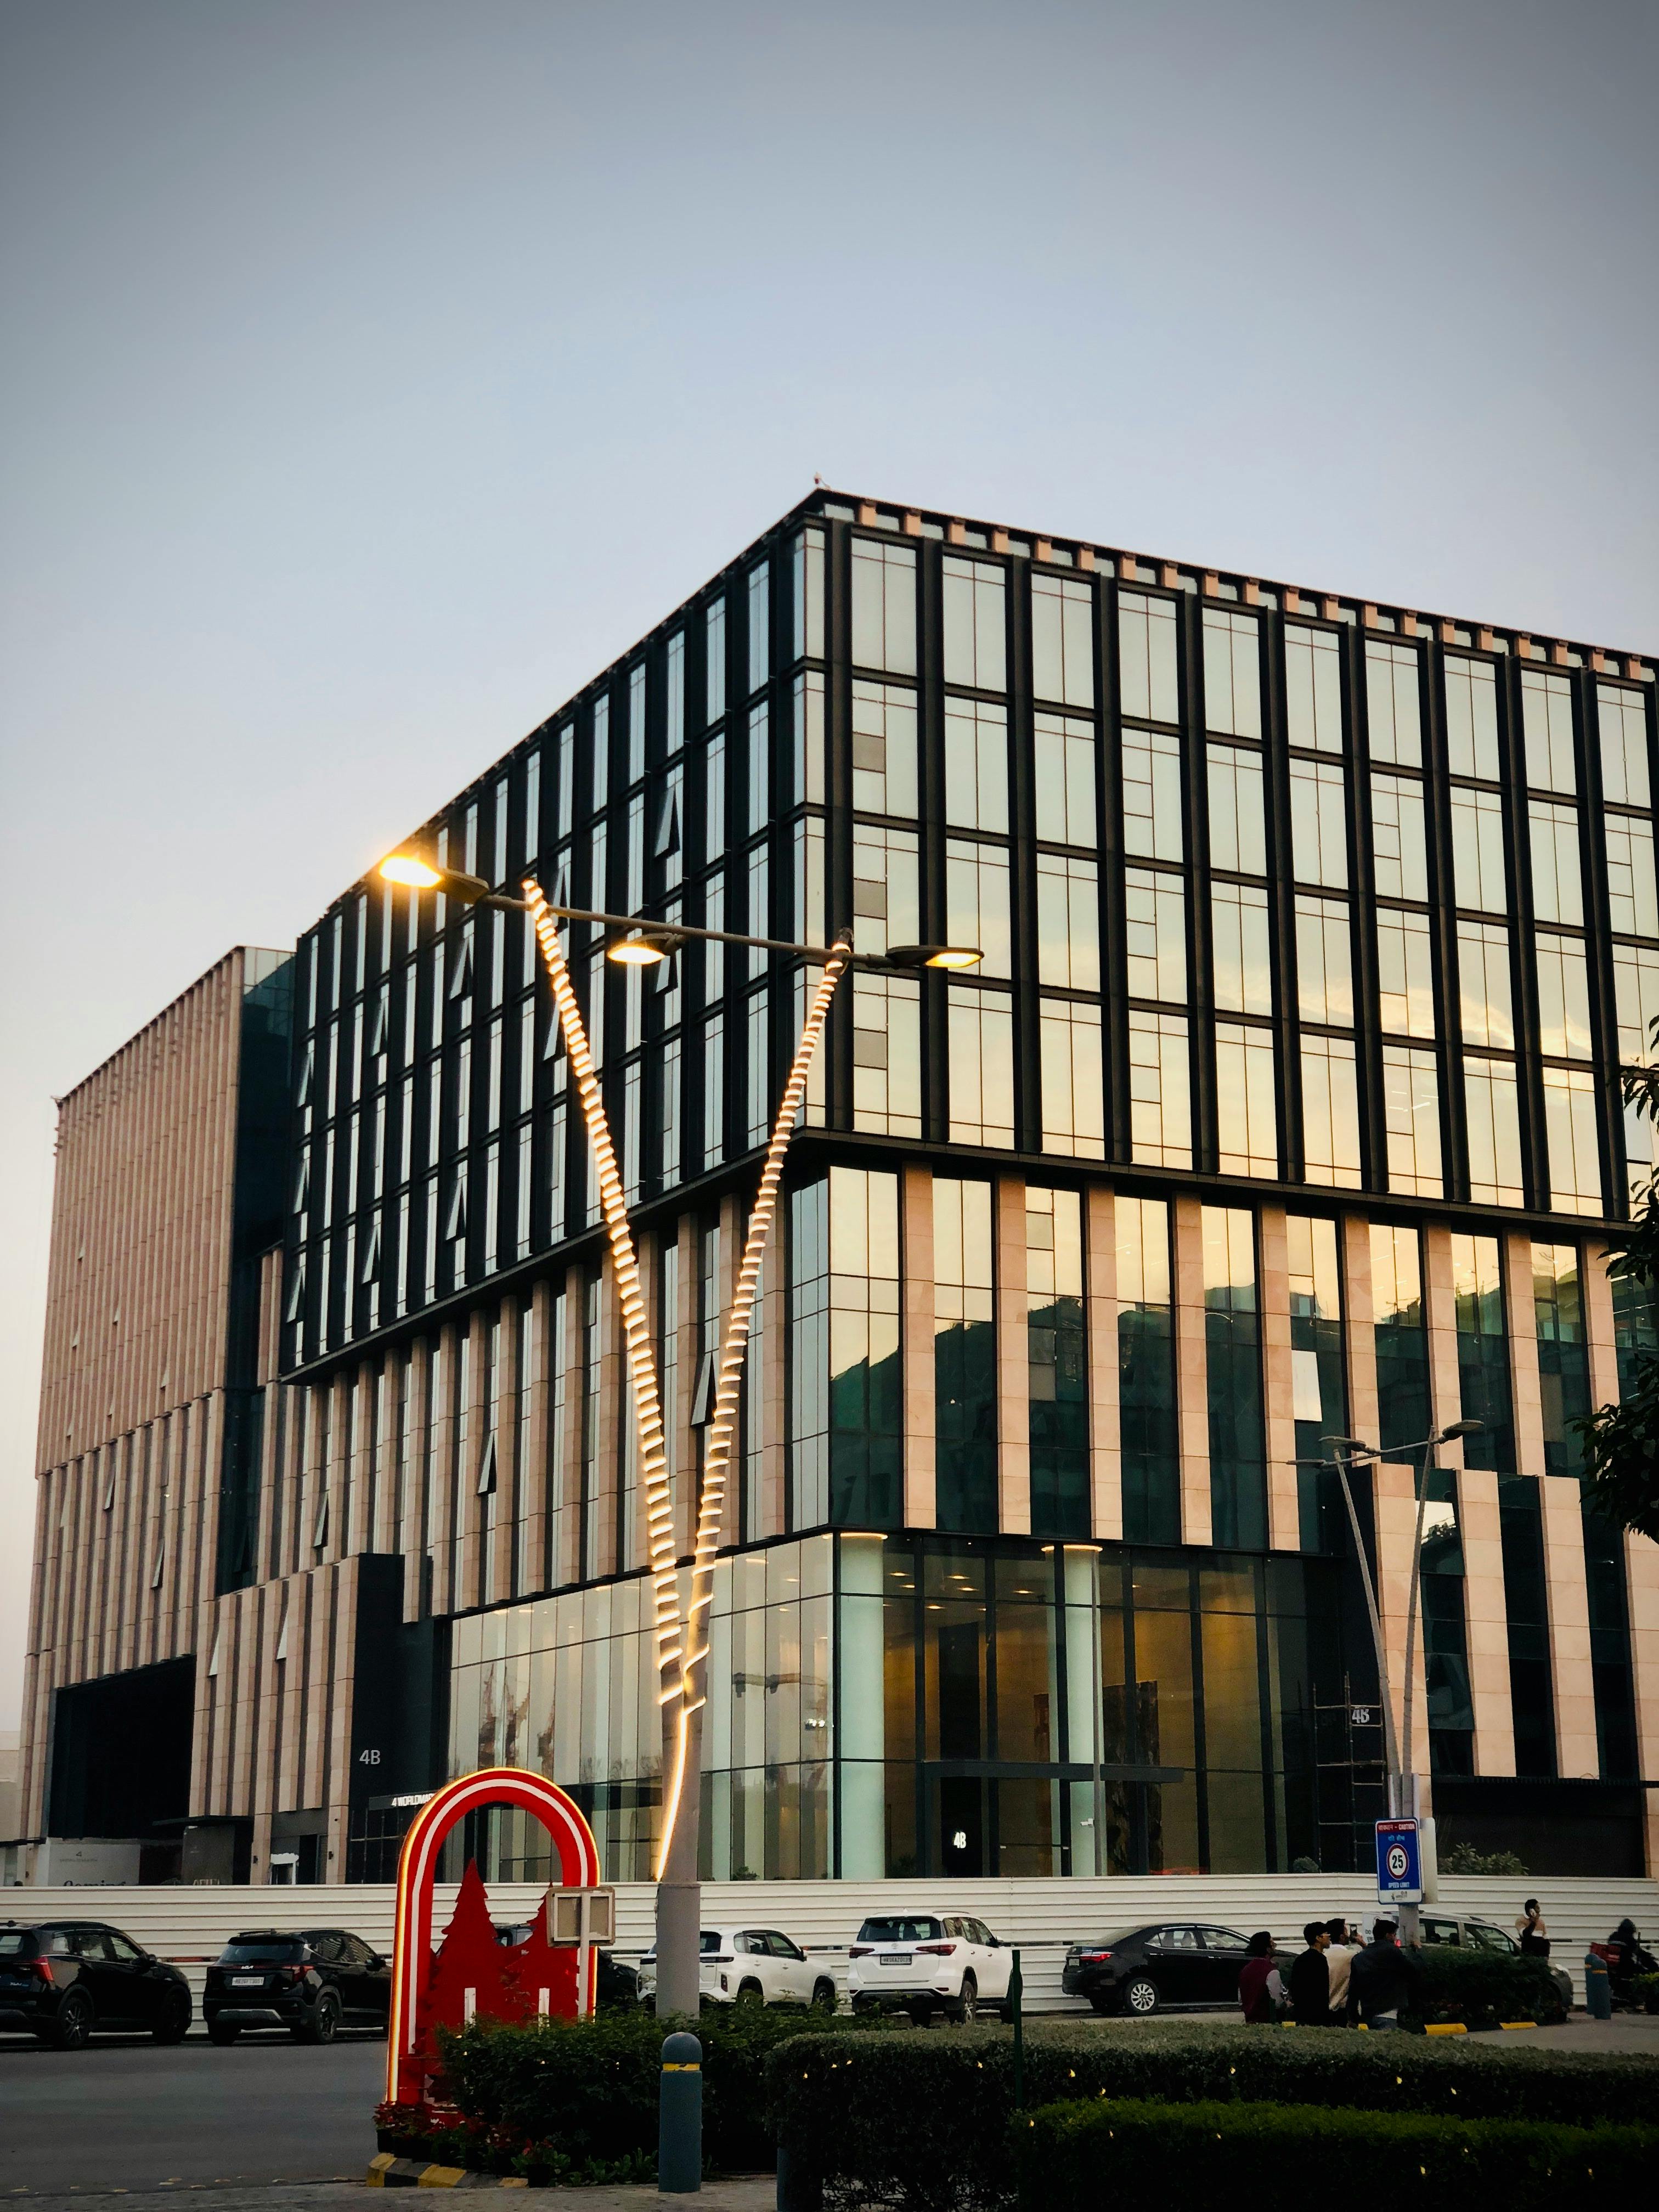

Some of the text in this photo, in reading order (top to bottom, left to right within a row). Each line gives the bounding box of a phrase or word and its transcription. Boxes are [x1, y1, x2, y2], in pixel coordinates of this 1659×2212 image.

[359, 1750, 381, 1765] 4B
[953, 1831, 967, 1849] 4B
[1392, 1854, 1404, 1869] 25
